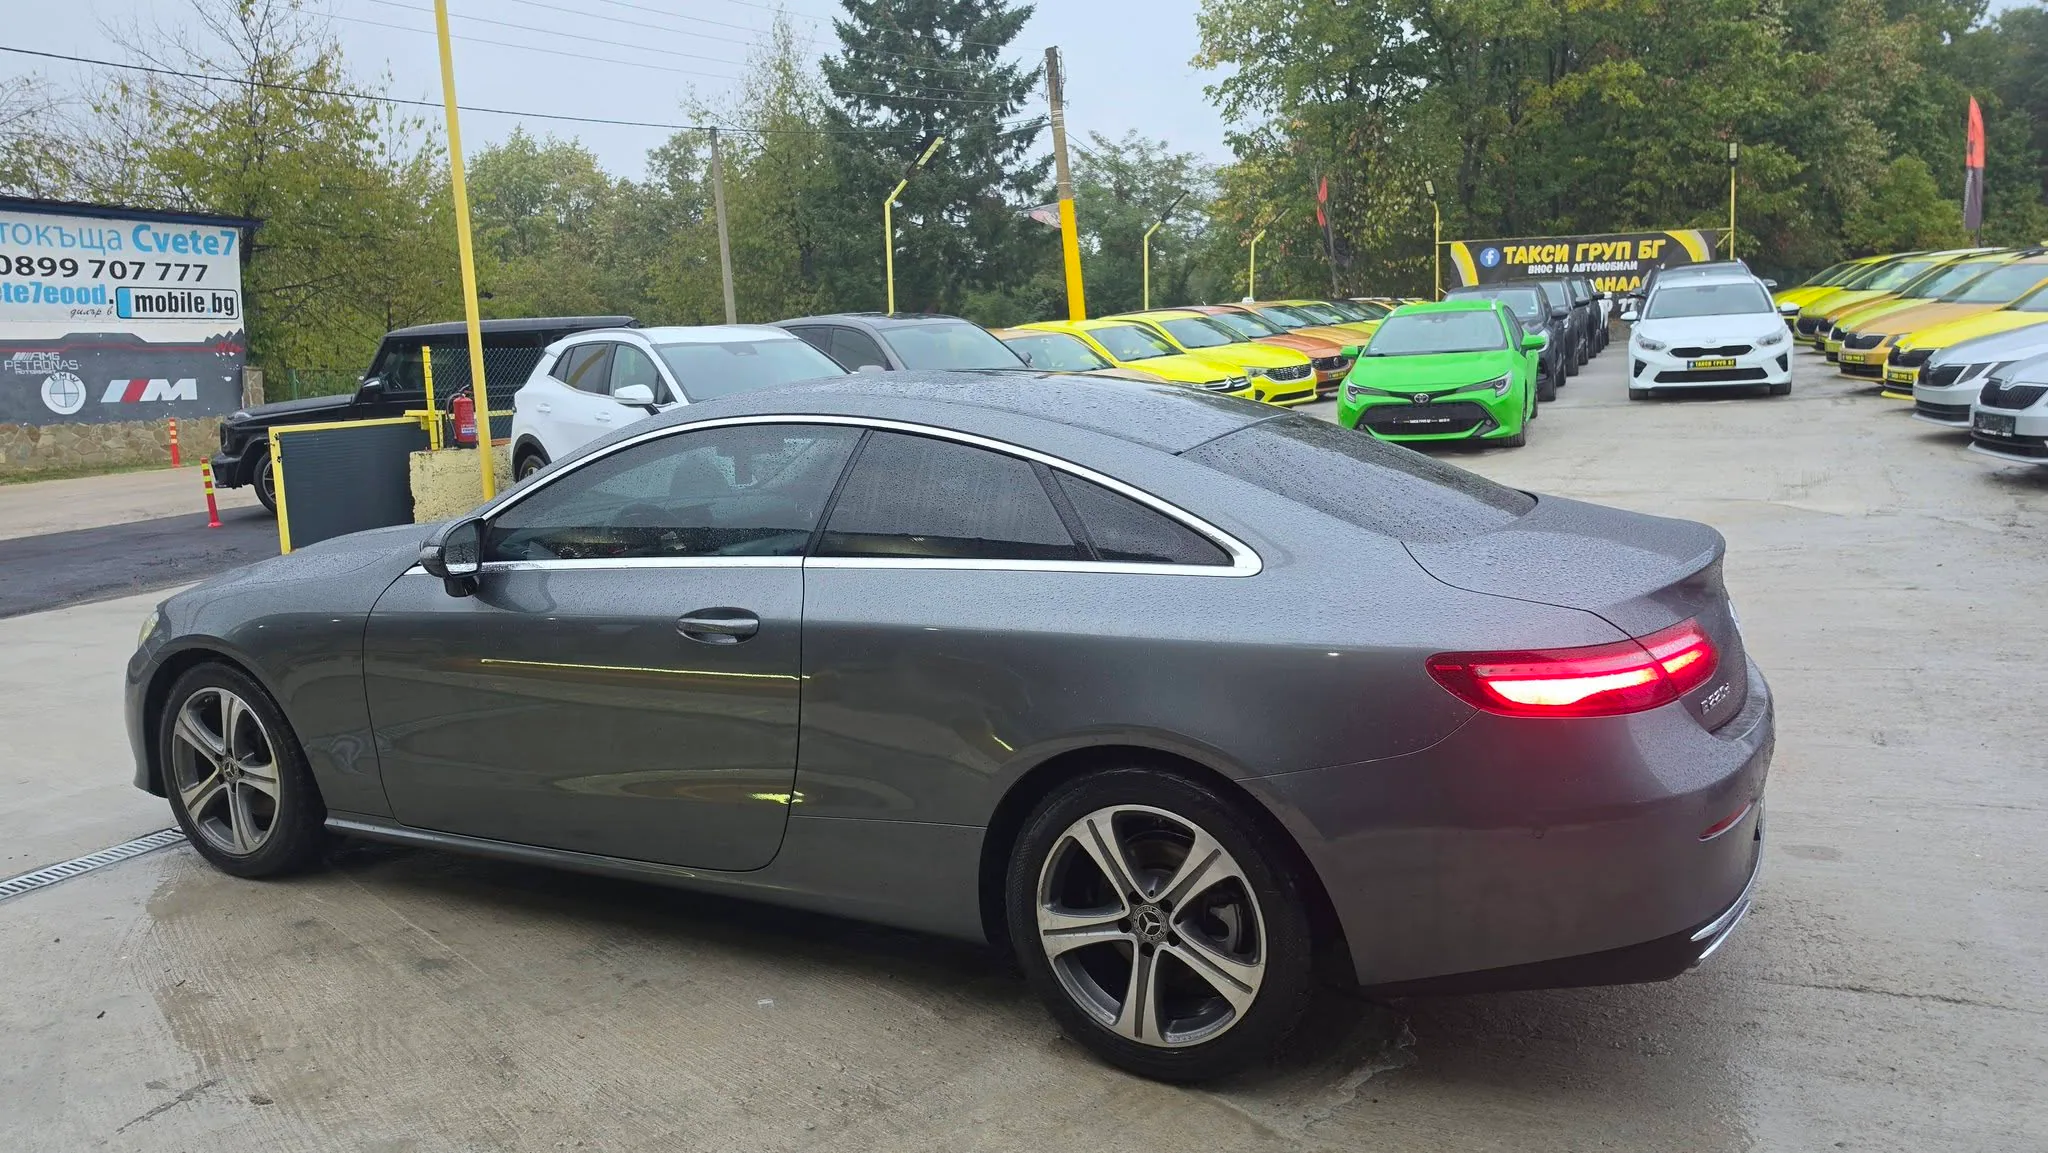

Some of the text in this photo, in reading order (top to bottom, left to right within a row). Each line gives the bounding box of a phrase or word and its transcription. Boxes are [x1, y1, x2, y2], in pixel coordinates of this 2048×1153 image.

[132, 224, 237, 256] Cvete7
[1503, 239, 1667, 264] ТАКСИ ГРУП БГ
[88, 259, 146, 280] 707
[155, 263, 208, 282] 777
[1528, 261, 1638, 274] ВНОС НА АВТОМОБИЛИ
[135, 292, 235, 316] mobile.bg
[4, 360, 79, 371] PETRONAS
[50, 372, 80, 383] BMW
